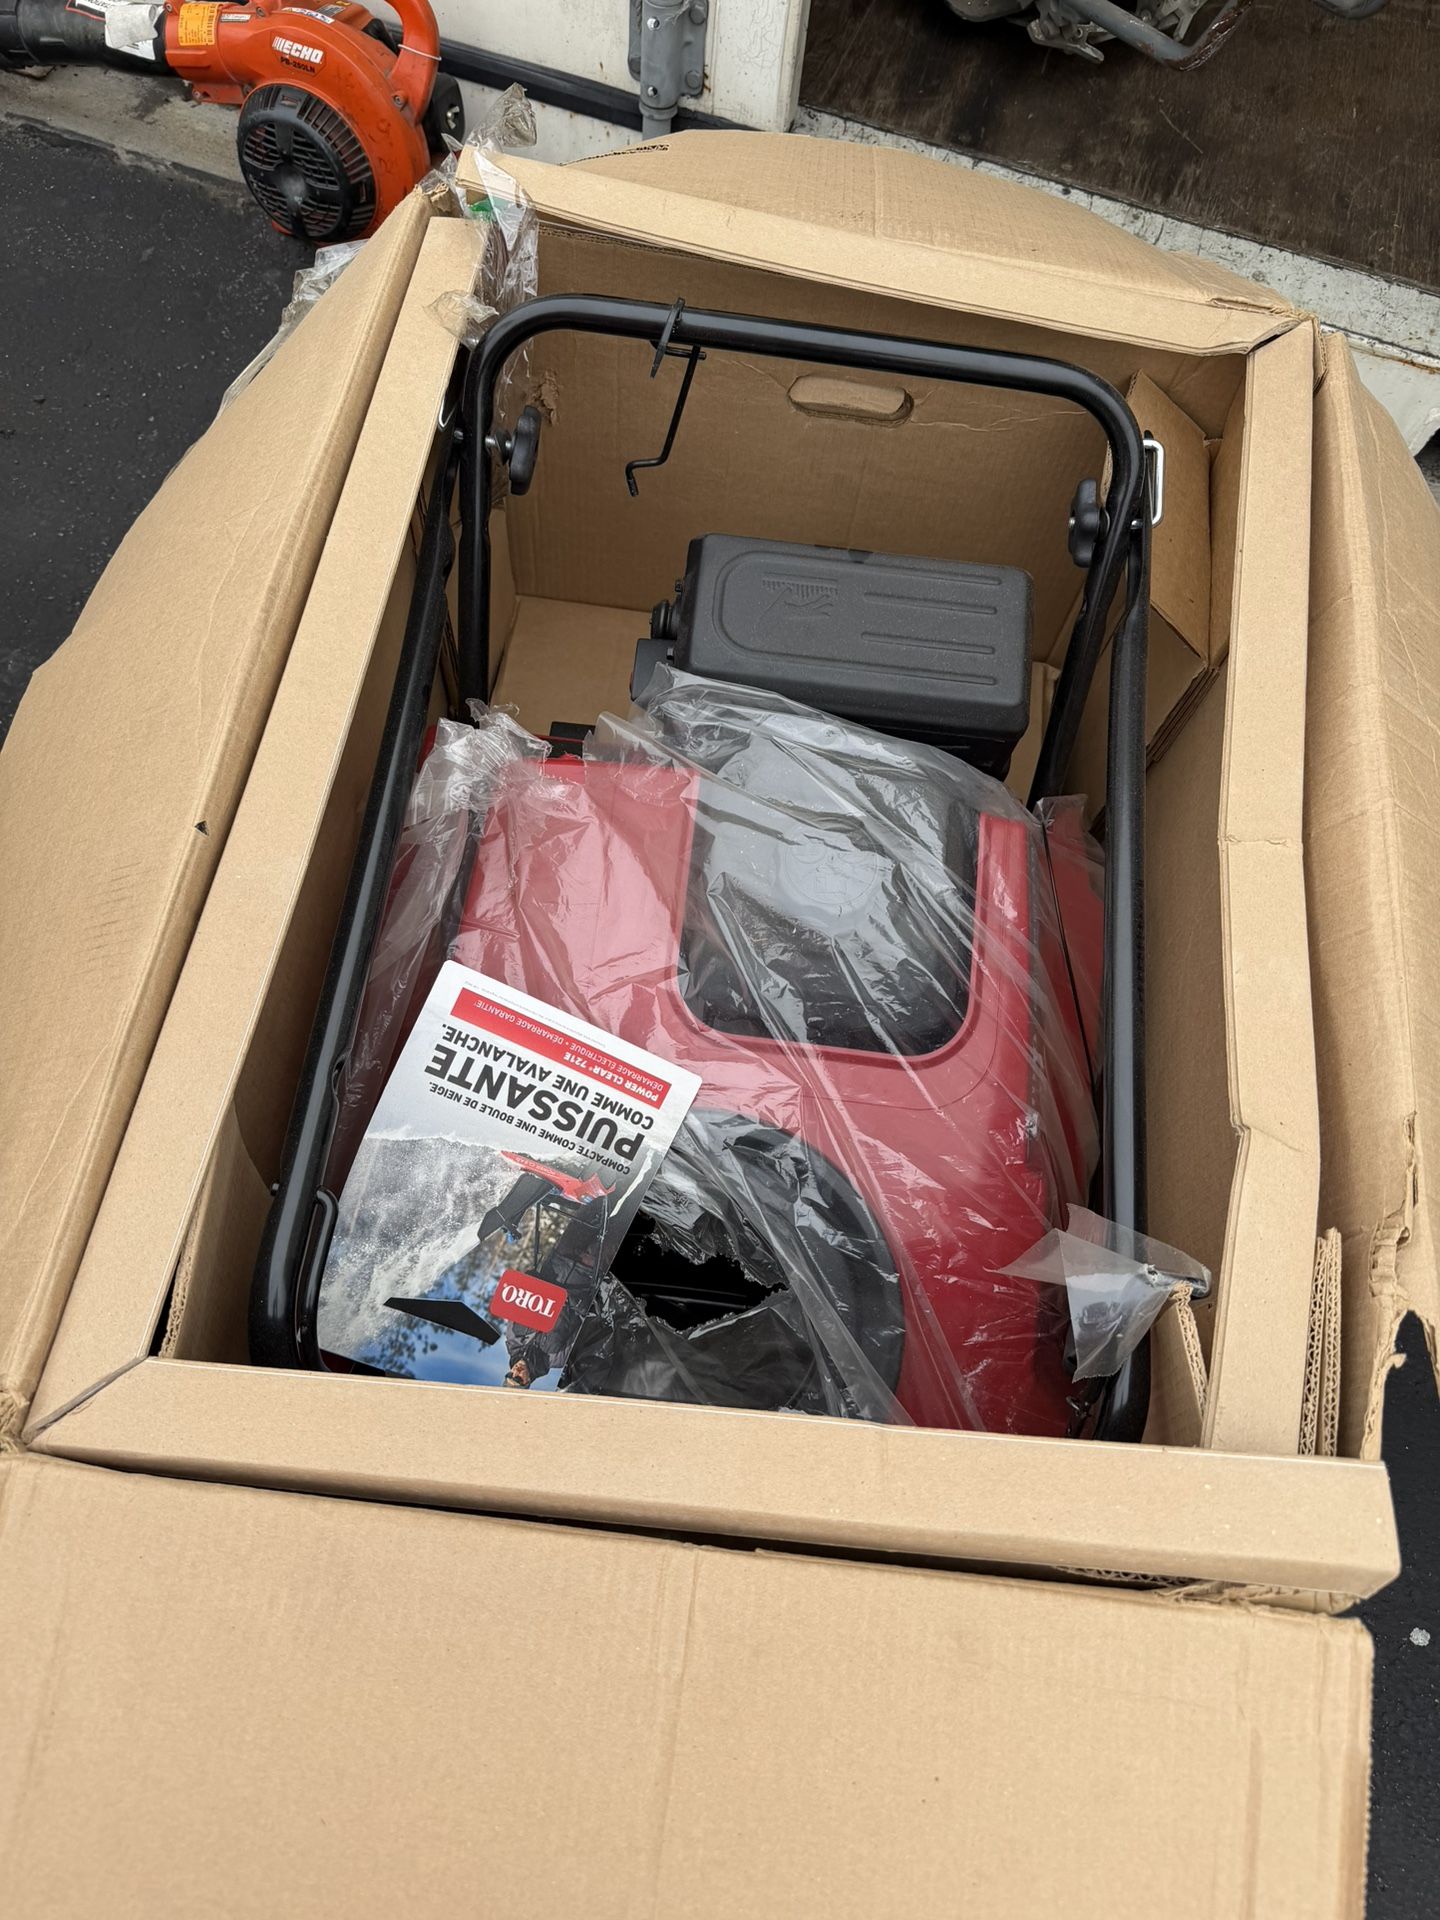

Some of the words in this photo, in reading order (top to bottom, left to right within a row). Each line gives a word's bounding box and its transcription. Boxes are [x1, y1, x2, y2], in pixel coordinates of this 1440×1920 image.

[271, 36, 323, 63] ECHO
[515, 1017, 564, 1045] DÉMARRAGE
[441, 1023, 552, 1082] AVALANCHE.
[562, 1051, 587, 1068] 721E
[568, 1041, 617, 1070] ÉLECTRIQUE
[428, 1081, 463, 1103] NEIGE.
[551, 1073, 589, 1101] UNE
[615, 1064, 664, 1092] DÉMARRAGE
[623, 1079, 659, 1102] POWER
[423, 1043, 645, 1162] PUISSANTE
[462, 1096, 479, 1109] DE
[478, 1102, 515, 1124] BOULE
[589, 1091, 654, 1130] COMME
[513, 1117, 537, 1134] UNE
[537, 1127, 576, 1151] COMME
[575, 1144, 631, 1175] COMPACTE
[501, 1282, 555, 1317] TORO
